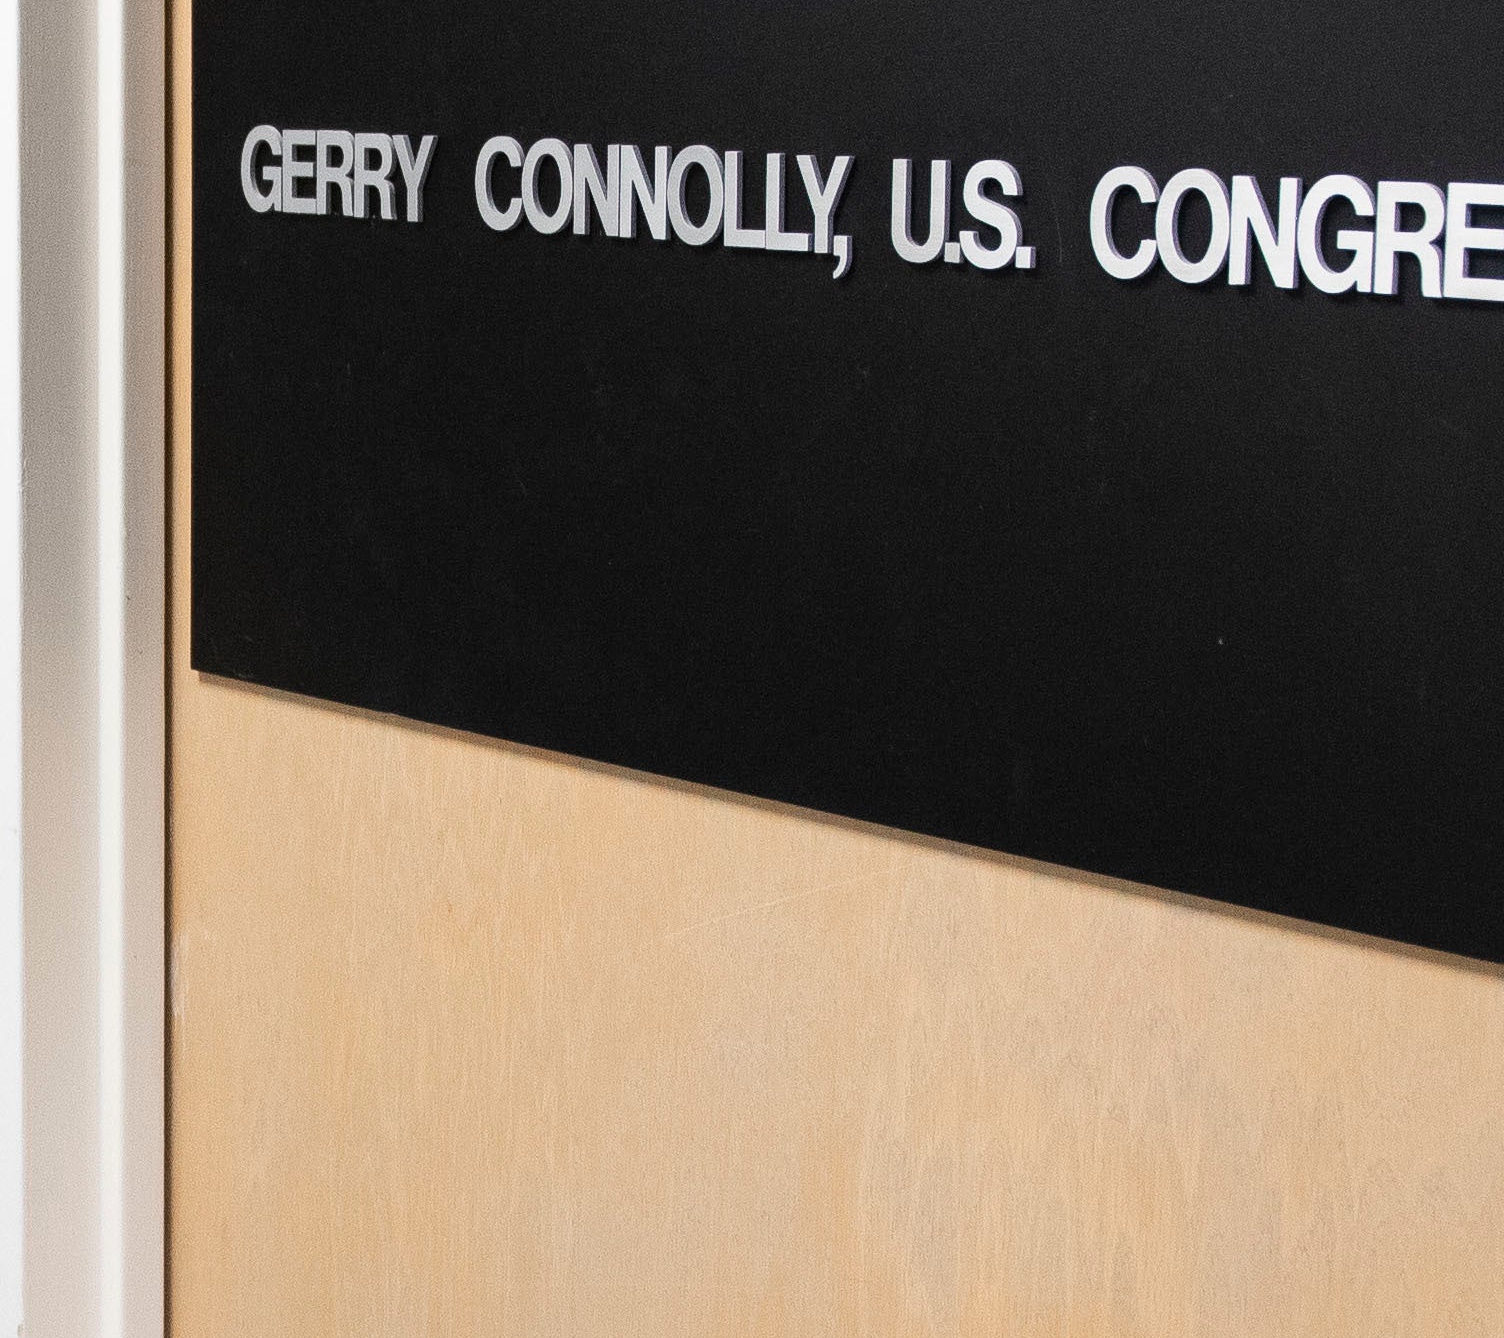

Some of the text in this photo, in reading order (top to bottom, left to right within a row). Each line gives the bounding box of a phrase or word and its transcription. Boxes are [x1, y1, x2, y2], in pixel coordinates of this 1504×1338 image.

[240, 124, 438, 223] GERRY
[475, 135, 854, 280] CONNOLLY,
[891, 158, 1037, 271] U.S.
